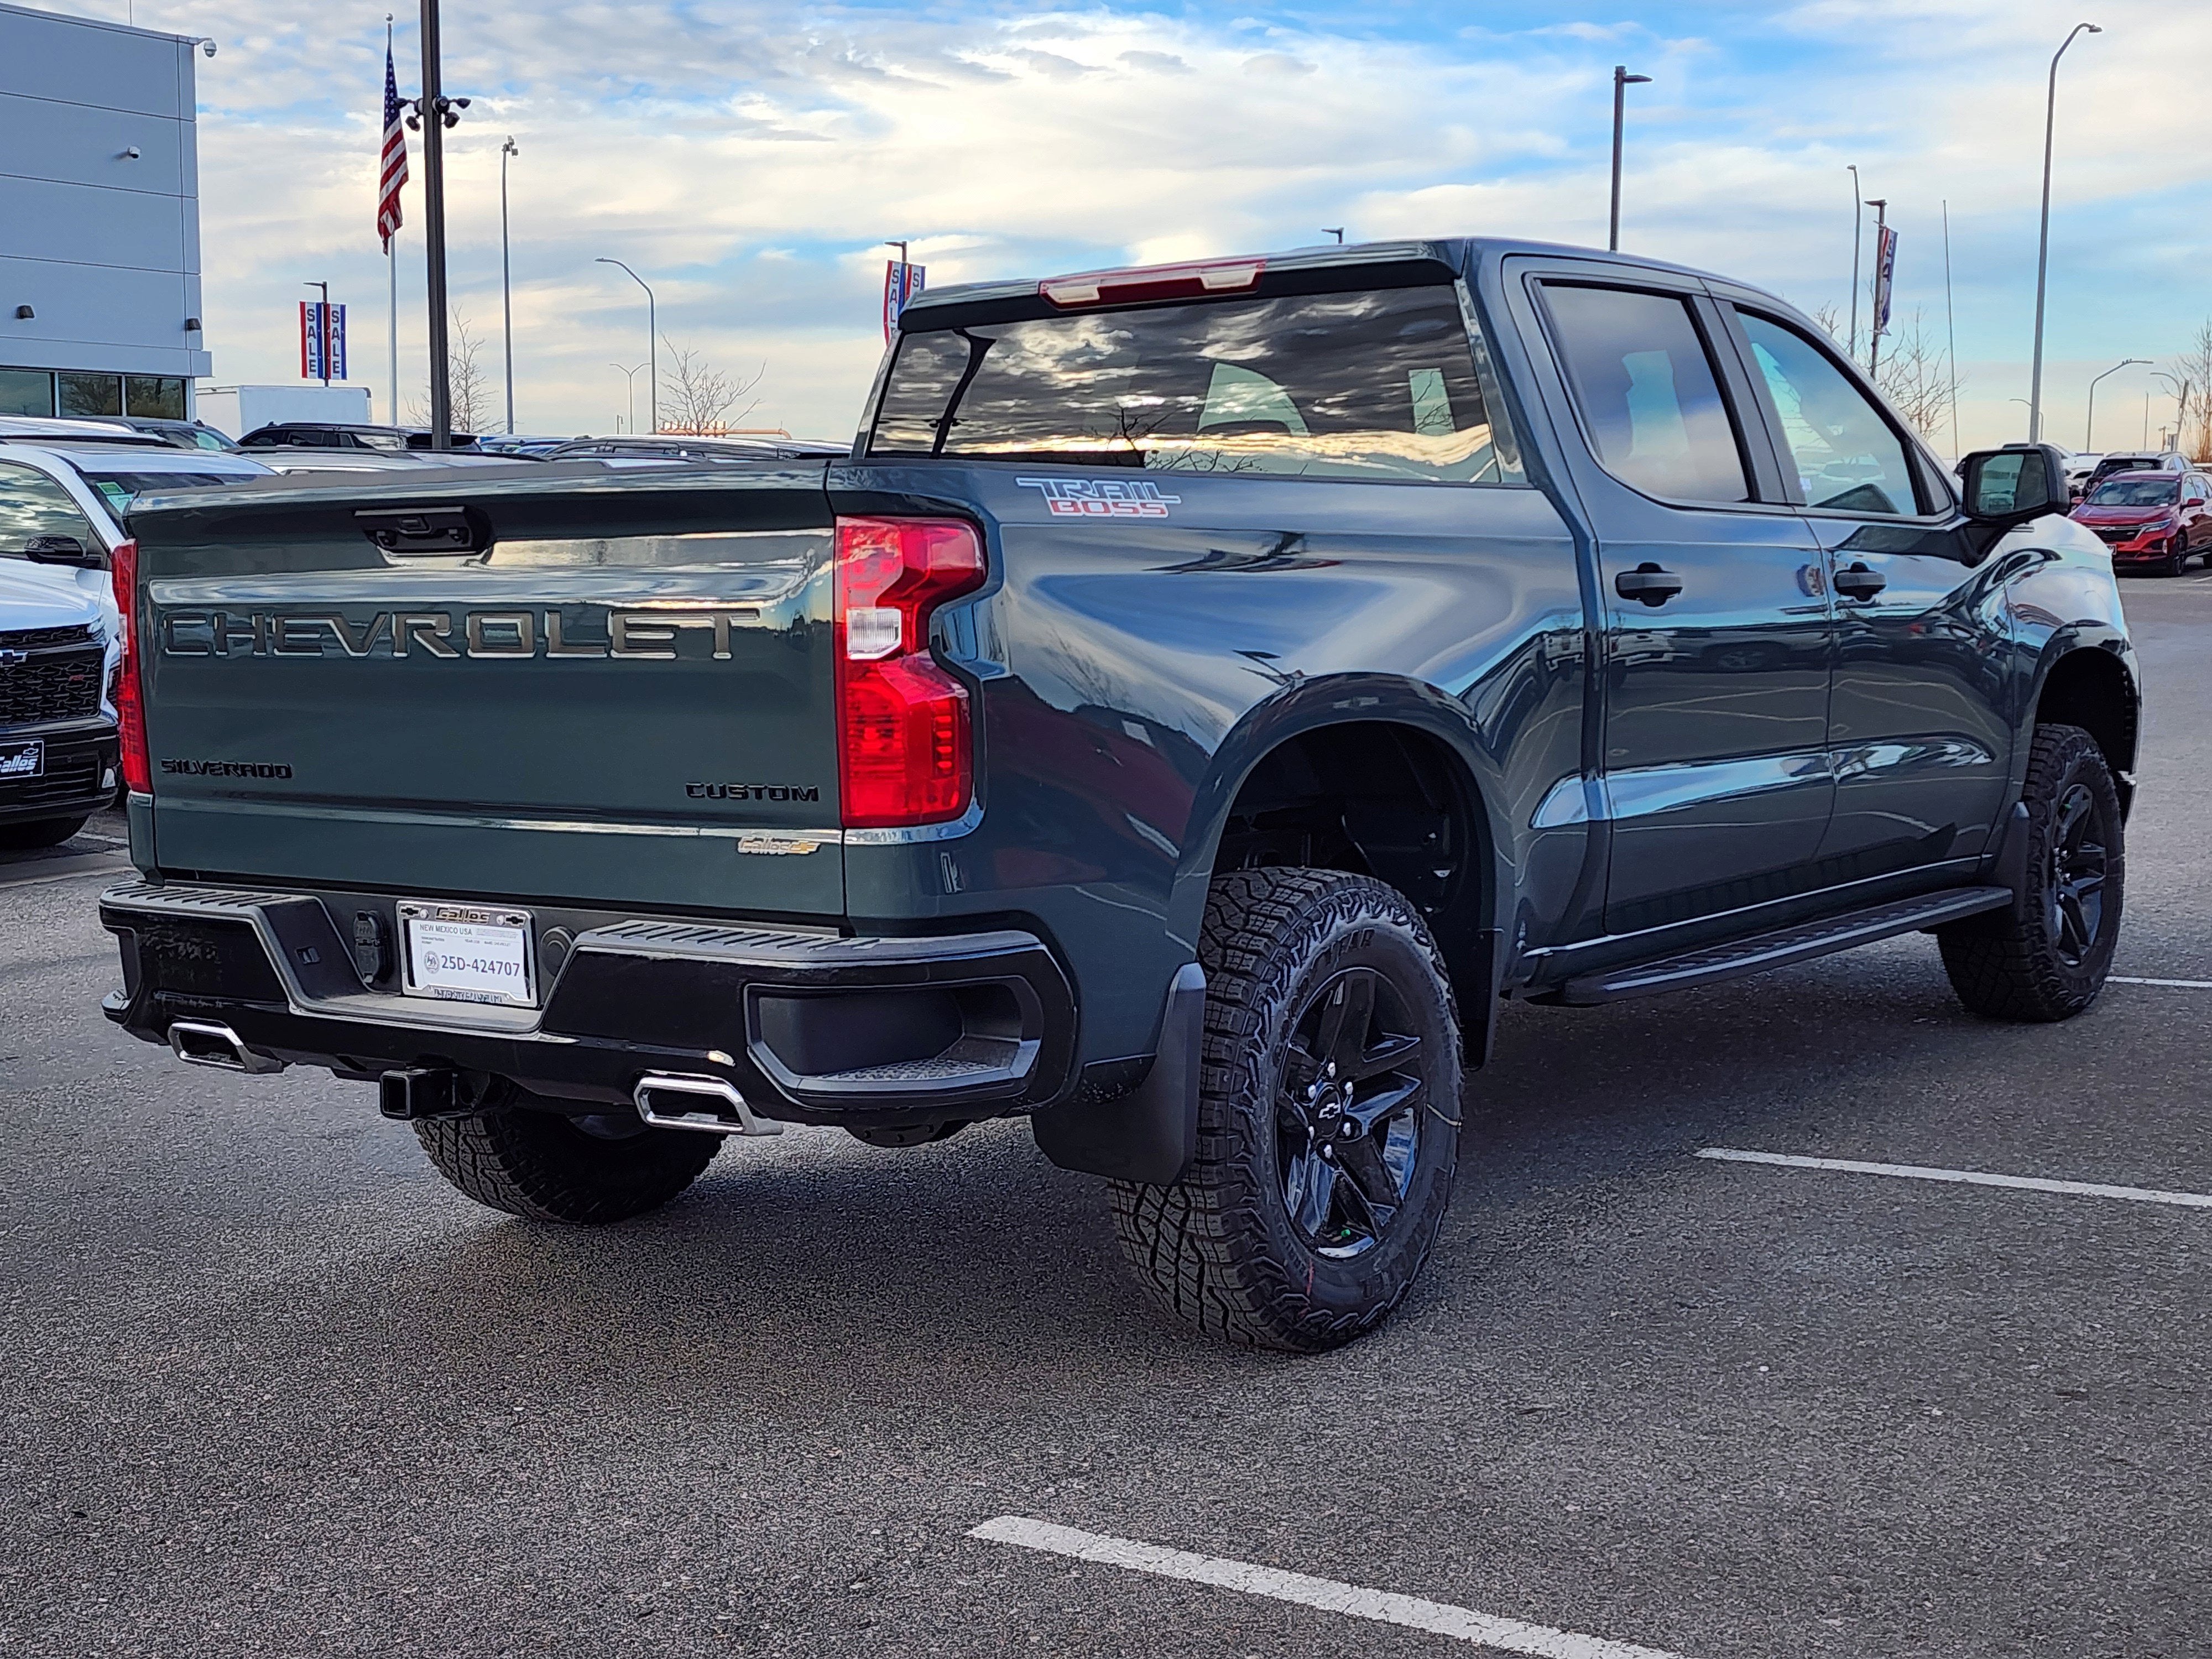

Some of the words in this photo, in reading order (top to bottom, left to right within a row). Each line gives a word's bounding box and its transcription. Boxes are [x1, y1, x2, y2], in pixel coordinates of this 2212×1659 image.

[306, 308, 316, 373] SALE
[331, 310, 340, 374] SALE
[1015, 476, 1182, 504] TRAIL
[1049, 498, 1169, 518] BOSS
[164, 609, 760, 660] CHEVROLET
[161, 758, 293, 779] SILVERADO
[685, 782, 820, 802] CUSTOM
[419, 924, 435, 932] NEW
[435, 925, 458, 935] MEXICO
[459, 927, 473, 936] USA
[441, 954, 520, 977] 25D-424707
